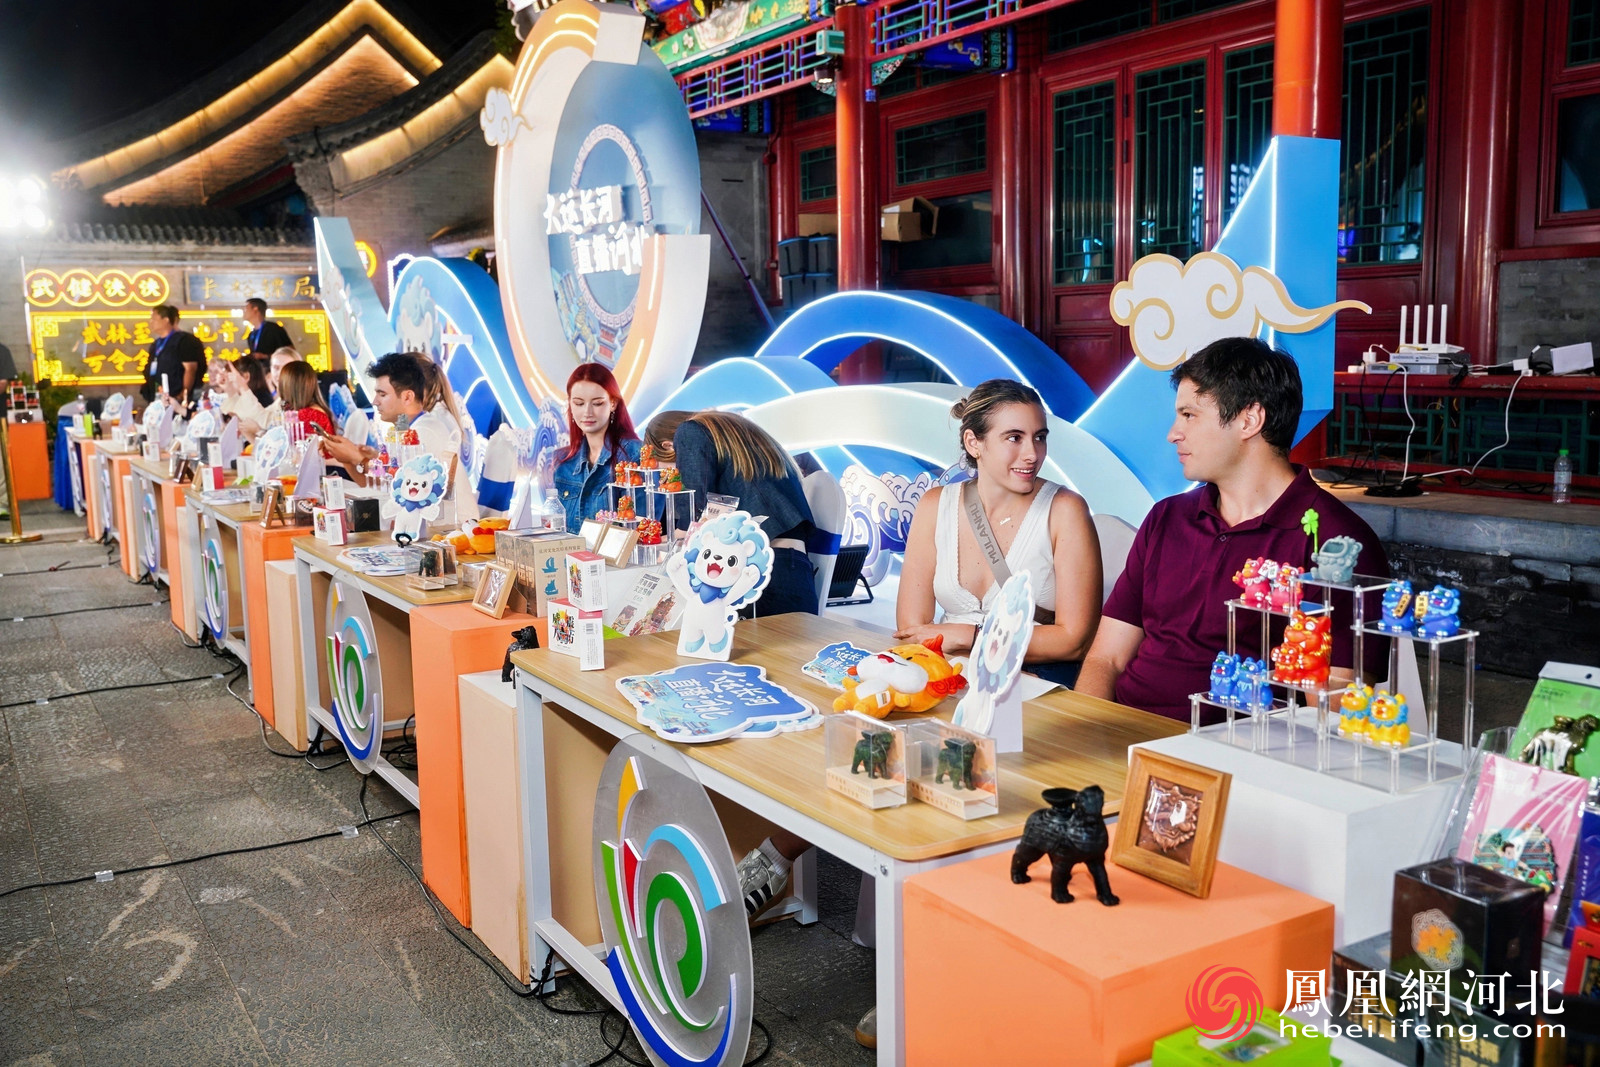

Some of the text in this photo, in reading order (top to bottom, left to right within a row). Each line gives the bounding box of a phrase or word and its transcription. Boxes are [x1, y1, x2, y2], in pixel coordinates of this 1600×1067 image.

[543, 185, 613, 235] 大运长河
[969, 502, 1000, 565] MULANHU
[830, 648, 867, 662] 大运长
[706, 669, 780, 706] 大运长河
